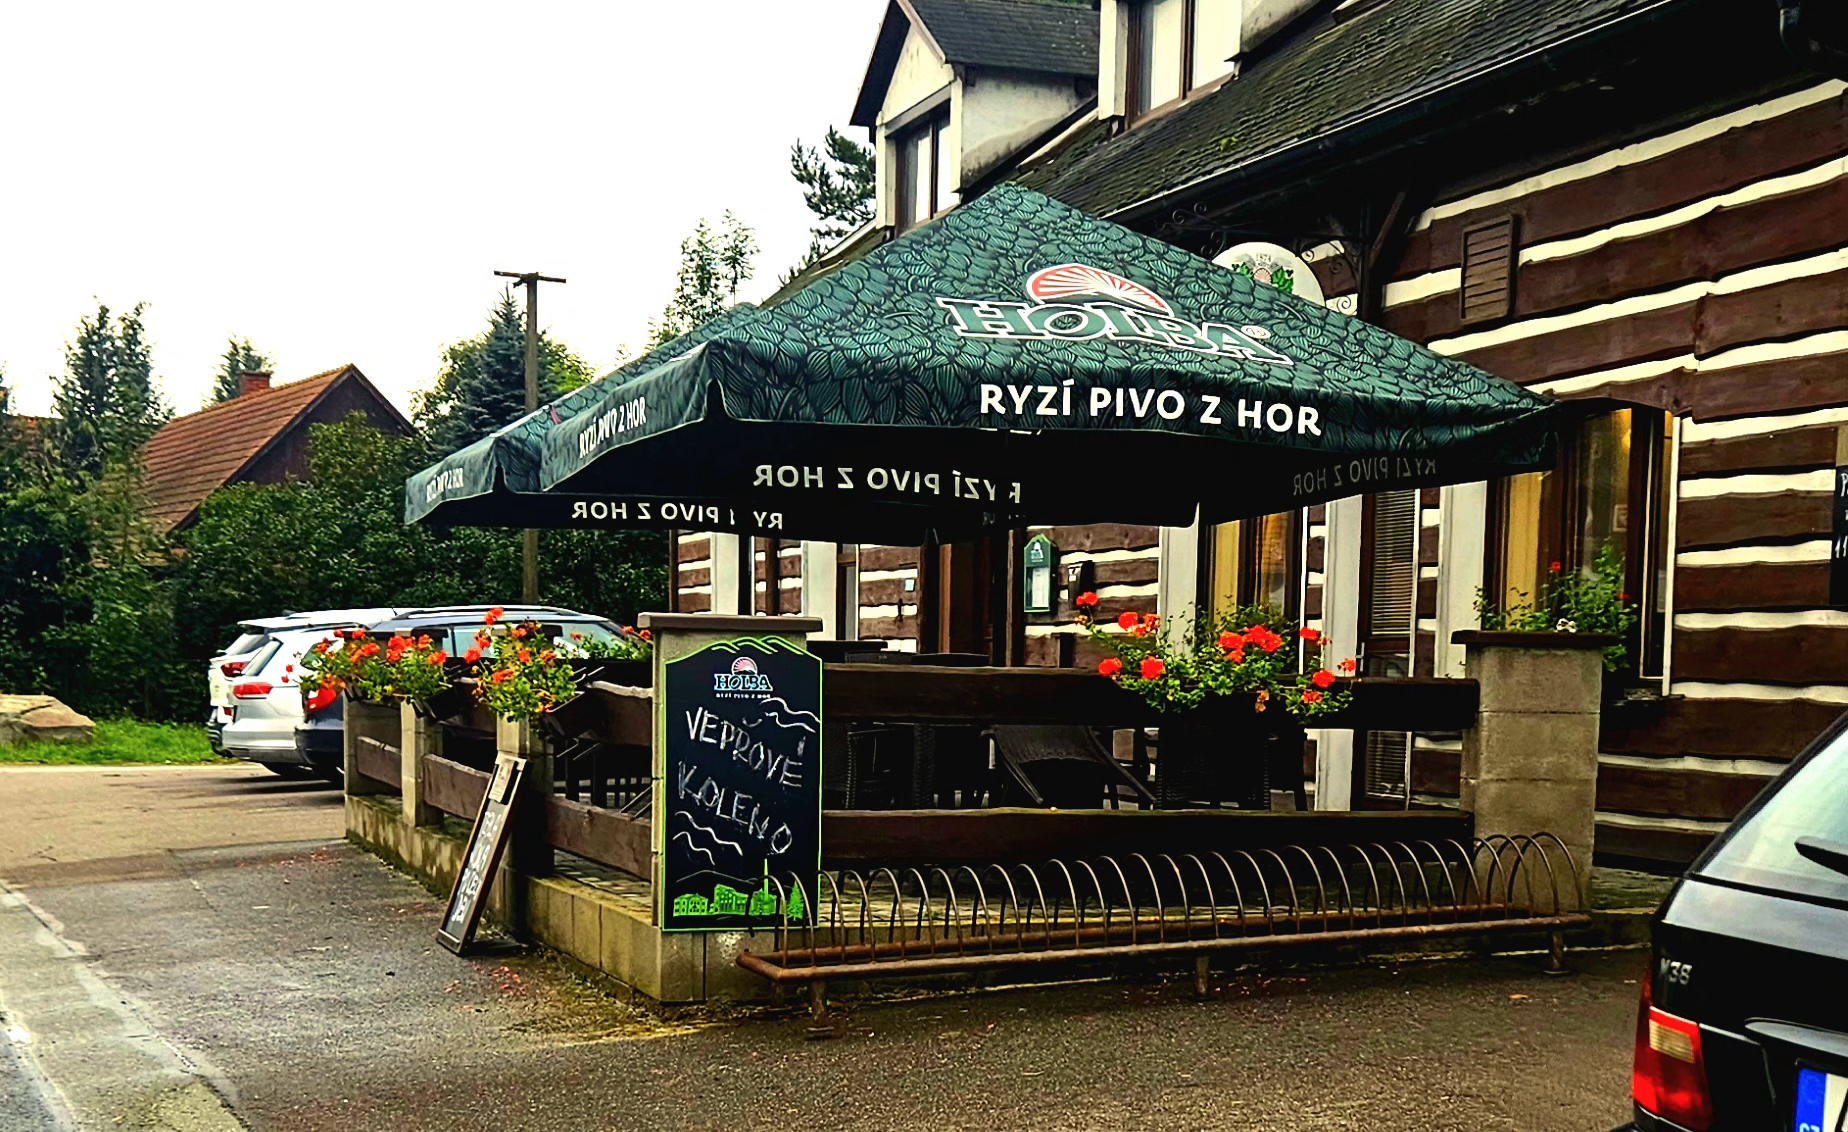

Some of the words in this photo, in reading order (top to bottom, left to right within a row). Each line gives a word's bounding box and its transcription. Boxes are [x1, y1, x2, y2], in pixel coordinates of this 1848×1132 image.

[936, 297, 1294, 366] HOLBA
[626, 396, 647, 431] HOR
[980, 379, 1074, 417] RYZÍ
[1090, 388, 1186, 420] PIVO
[1200, 396, 1222, 425] Z
[1237, 399, 1322, 437] HOR
[714, 674, 774, 691] HOLBA
[678, 760, 793, 855] KOLENO
